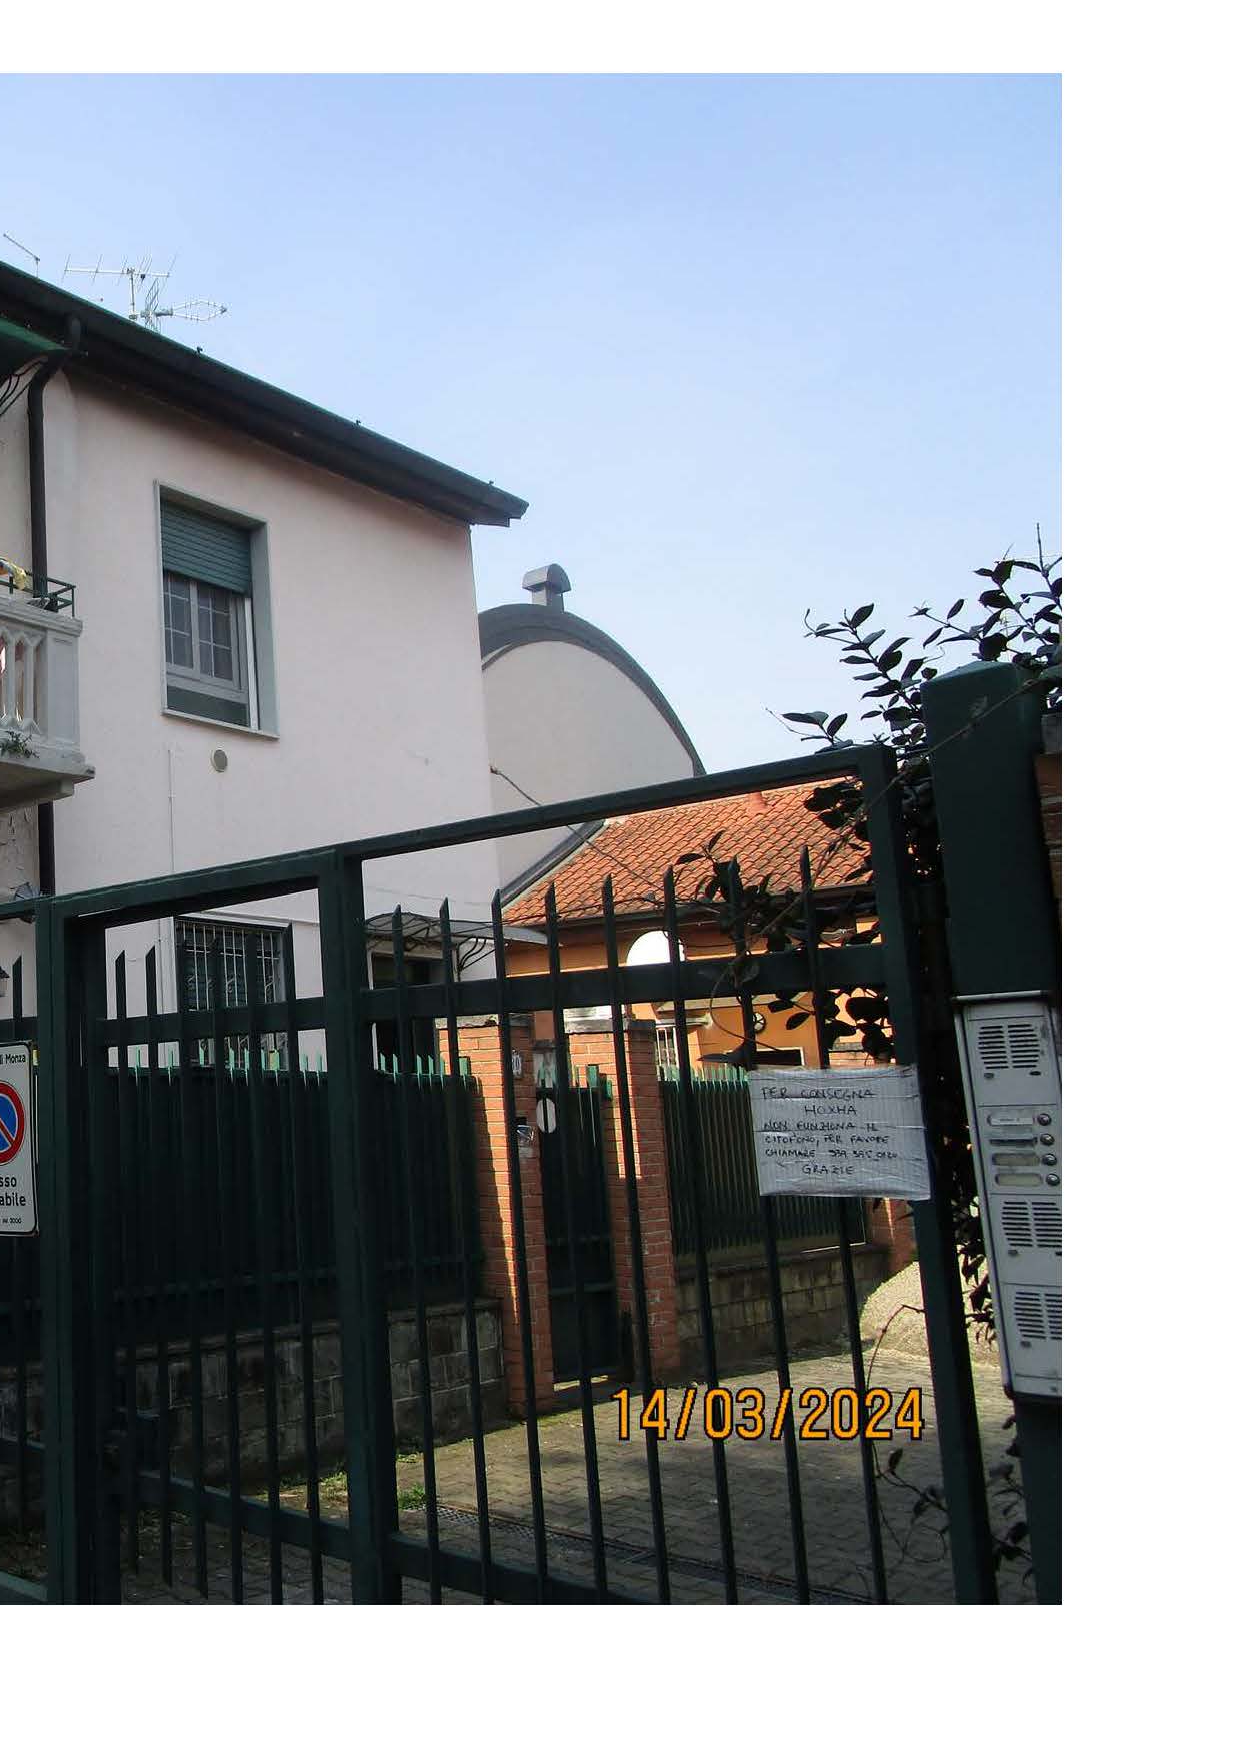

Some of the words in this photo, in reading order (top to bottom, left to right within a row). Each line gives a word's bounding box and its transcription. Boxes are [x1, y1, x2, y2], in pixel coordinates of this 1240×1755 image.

[5, 1053, 27, 1064] Monza
[761, 1086, 788, 1100] PER
[800, 1088, 876, 1101] CONSEGNA
[804, 1104, 858, 1116] HOXHA
[763, 1120, 788, 1132] NON
[802, 1164, 855, 1176] GRAZIE
